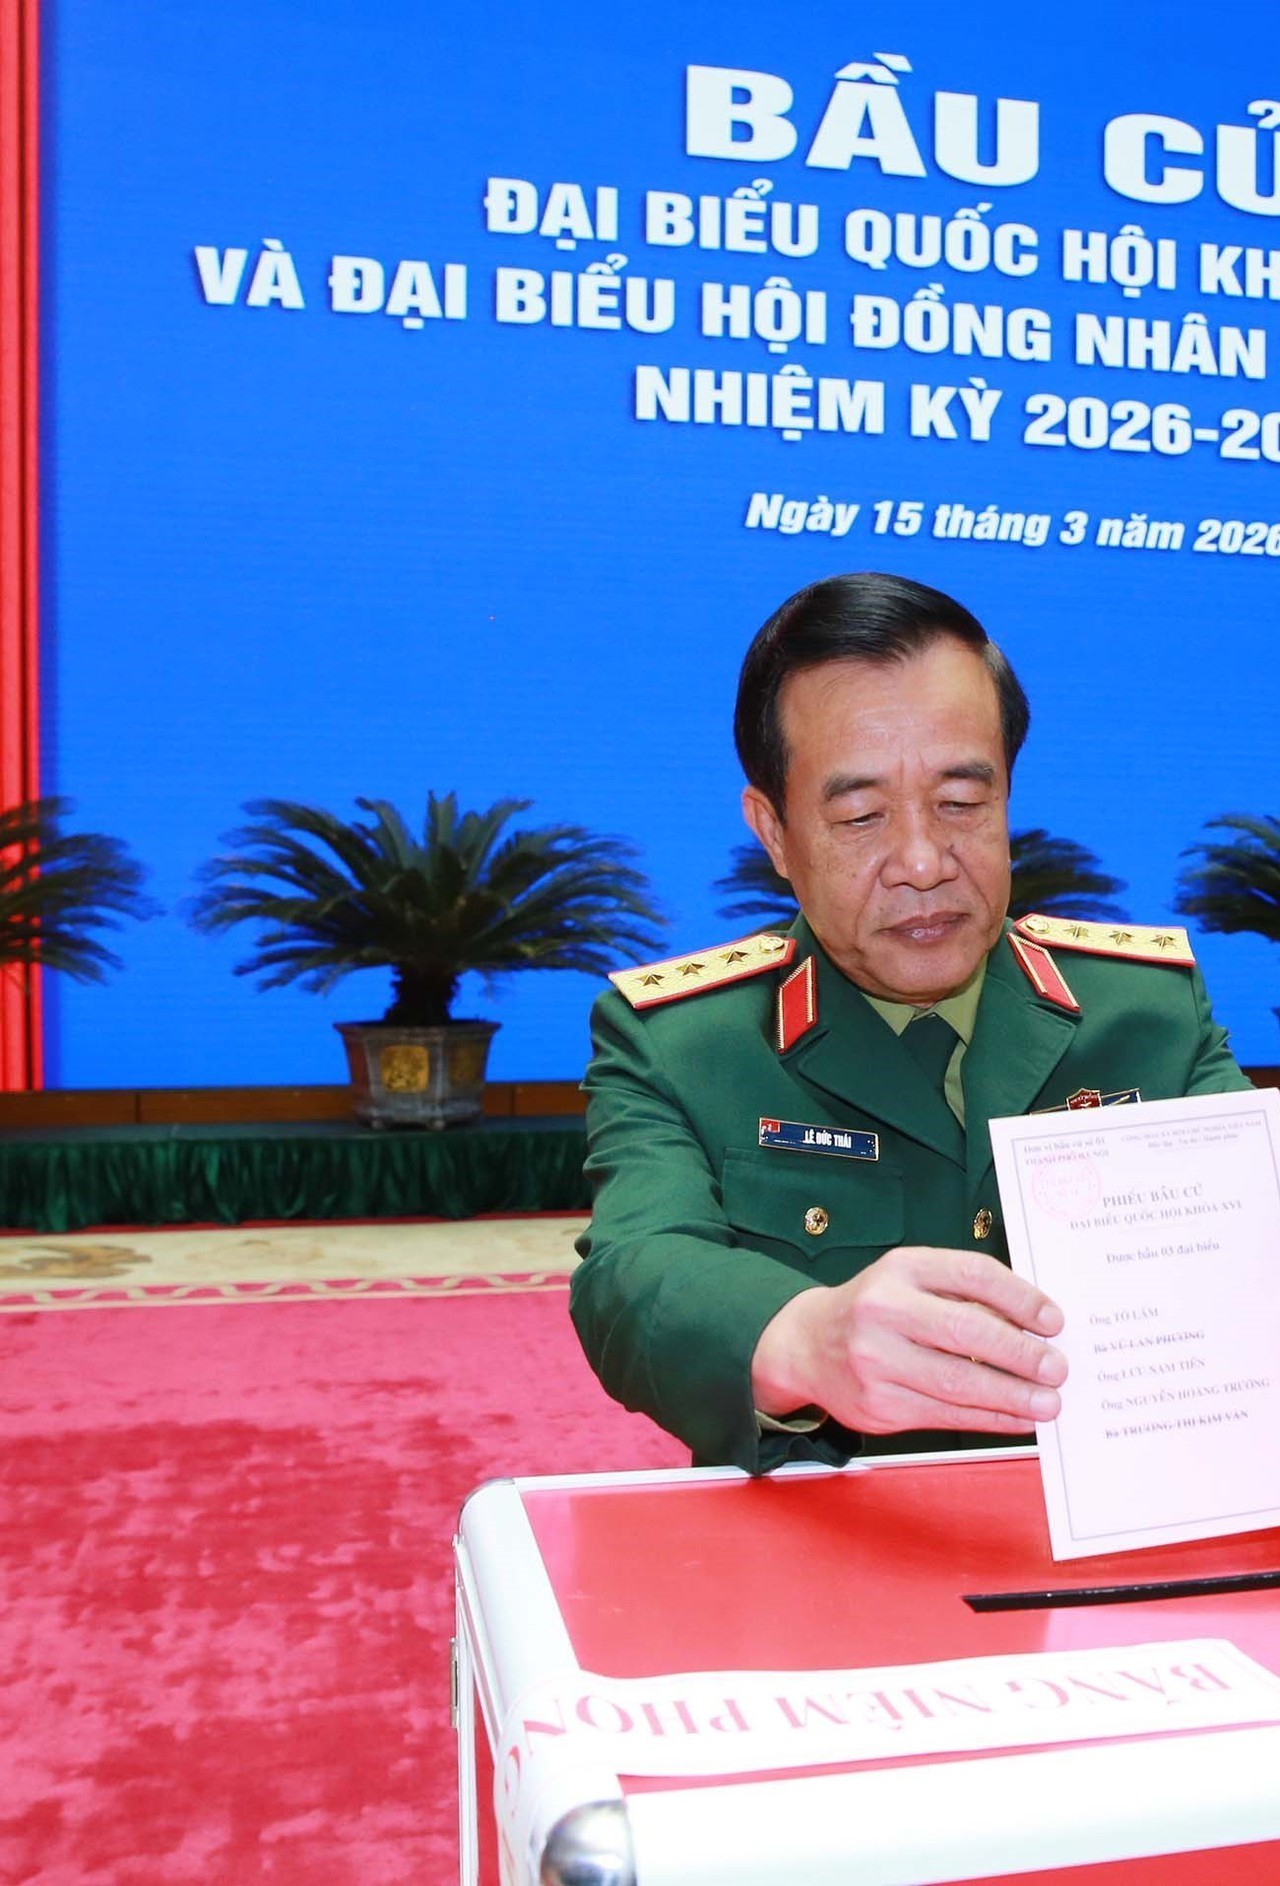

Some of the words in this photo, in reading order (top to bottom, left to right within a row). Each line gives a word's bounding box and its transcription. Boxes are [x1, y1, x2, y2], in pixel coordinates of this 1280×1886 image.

[686, 52, 1039, 186] BẦU
[483, 177, 618, 250] ĐẠI
[646, 178, 819, 257] BIỂU
[845, 202, 1038, 276] QUỐC
[1063, 224, 1176, 298] HỘI
[194, 238, 304, 309] VÀ
[328, 255, 467, 329] ĐẠI
[496, 253, 675, 333] BIỂU
[702, 276, 827, 353] HỘI
[850, 283, 1051, 361] ĐỒNG
[1076, 312, 1266, 379] NHÂN
[636, 364, 885, 441] NHIỆM
[911, 377, 1002, 441] KỲ
[745, 492, 860, 536] Ngày
[874, 500, 924, 536] 15
[933, 503, 1051, 546] tháng
[1059, 510, 1089, 545] 3
[1096, 513, 1185, 550] năm
[803, 1128, 815, 1144] LÊ
[834, 1133, 852, 1149] THÁI
[1102, 1188, 1146, 1208] PHIẾU
[1150, 1184, 1180, 1202] BẦU
[1183, 1182, 1204, 1199] CỬ
[1137, 1245, 1159, 1260] bầu
